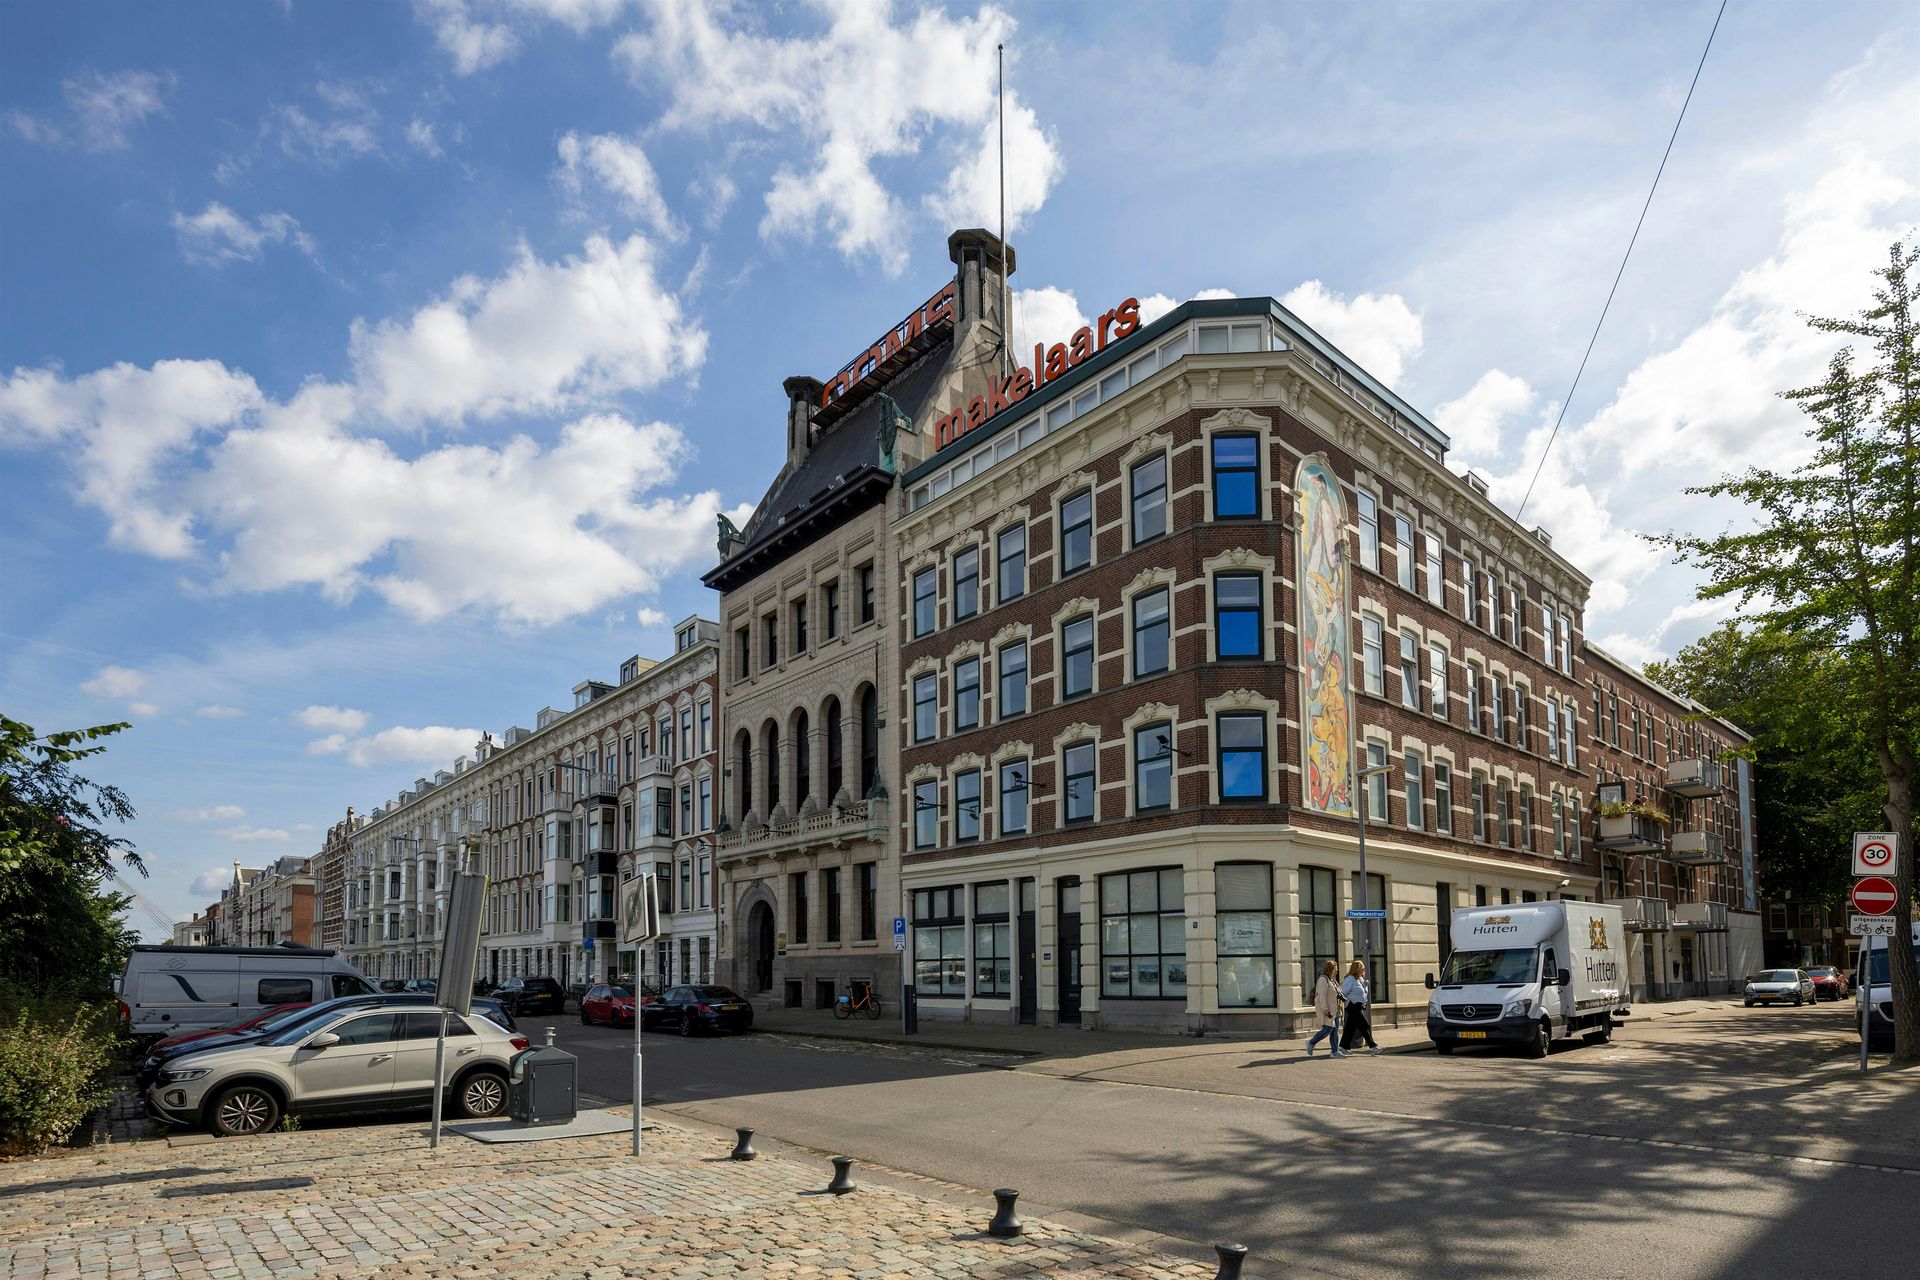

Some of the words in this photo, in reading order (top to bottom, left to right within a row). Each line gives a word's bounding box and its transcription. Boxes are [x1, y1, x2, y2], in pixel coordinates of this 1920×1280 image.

[935, 297, 1141, 450] makelaars
[1866, 849, 1887, 860] 30
[895, 920, 902, 932] P
[1473, 925, 1518, 935] Hutten
[1585, 957, 1617, 983] Hutten
